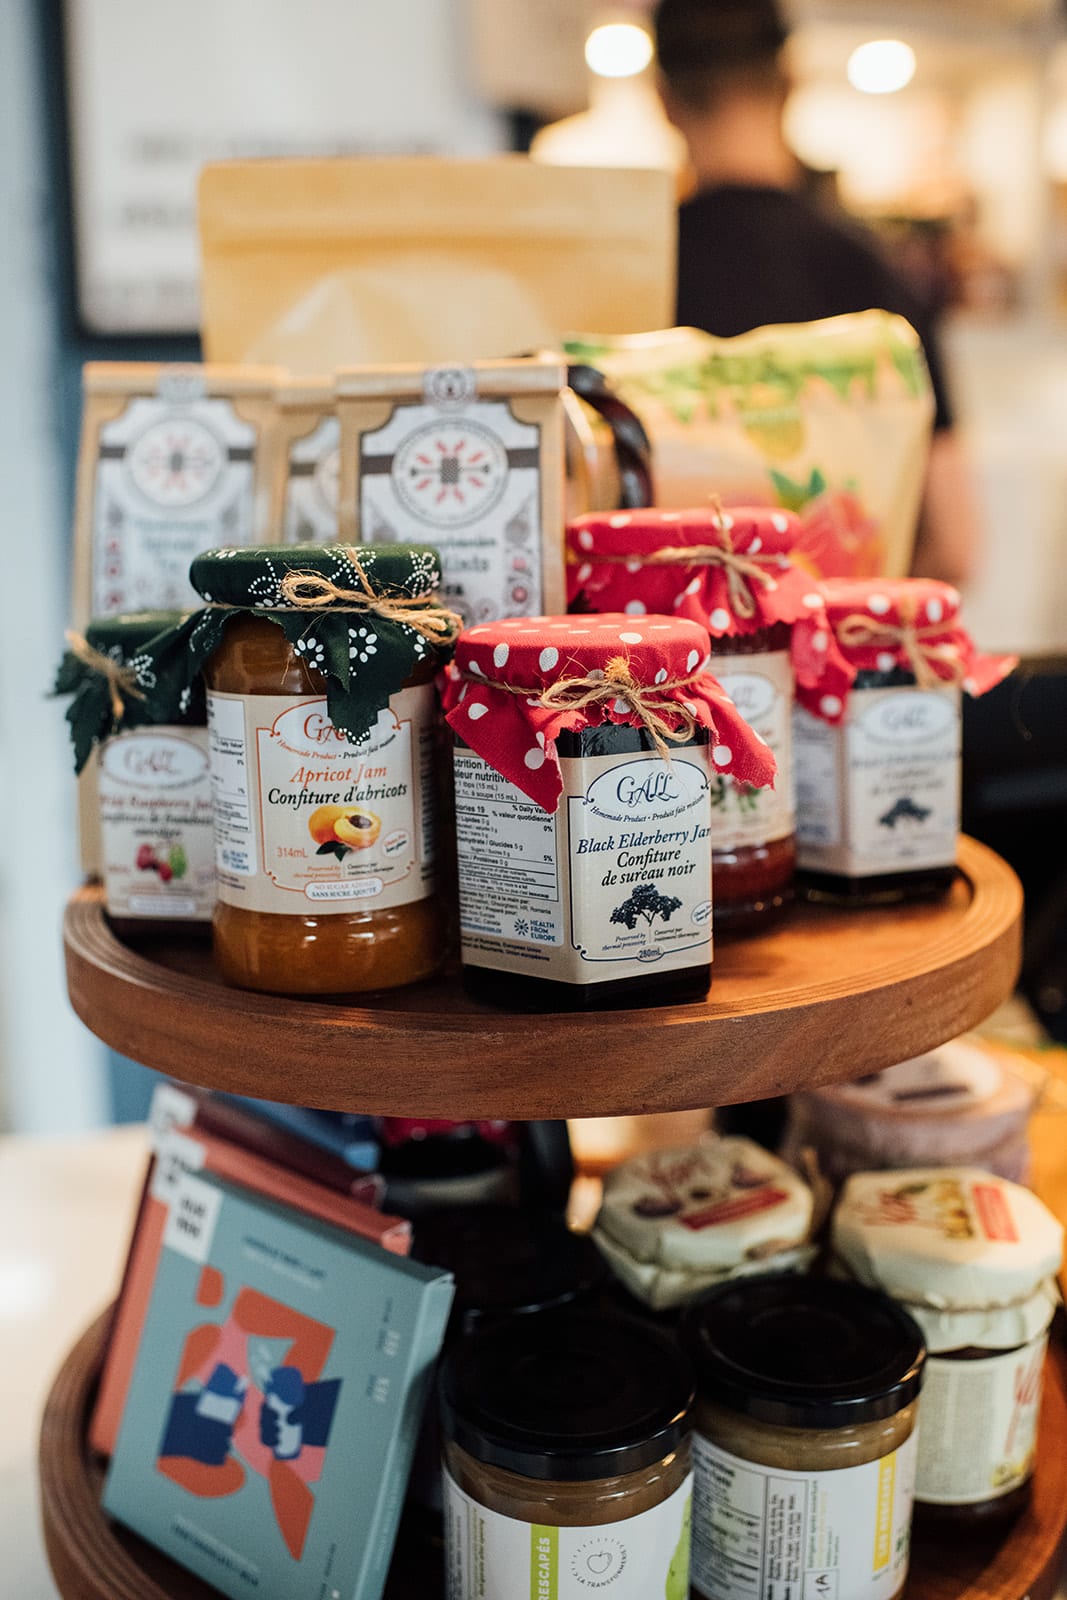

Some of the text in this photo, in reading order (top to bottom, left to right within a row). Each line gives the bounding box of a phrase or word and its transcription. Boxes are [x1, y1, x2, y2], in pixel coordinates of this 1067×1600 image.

[289, 763, 388, 791] Apricot Jam
[268, 787, 341, 811] Confiture
[343, 783, 408, 802] d'abricots
[616, 772, 679, 808] GÁLL
[277, 847, 309, 859] 314mL
[576, 835, 615, 855] Black
[618, 829, 690, 850] Elderberry
[616, 848, 682, 871] Confiture
[601, 859, 697, 887] de sureau noir
[530, 919, 555, 929] HEALTH
[530, 926, 549, 935] FROM
[531, 932, 556, 943] EUROPE
